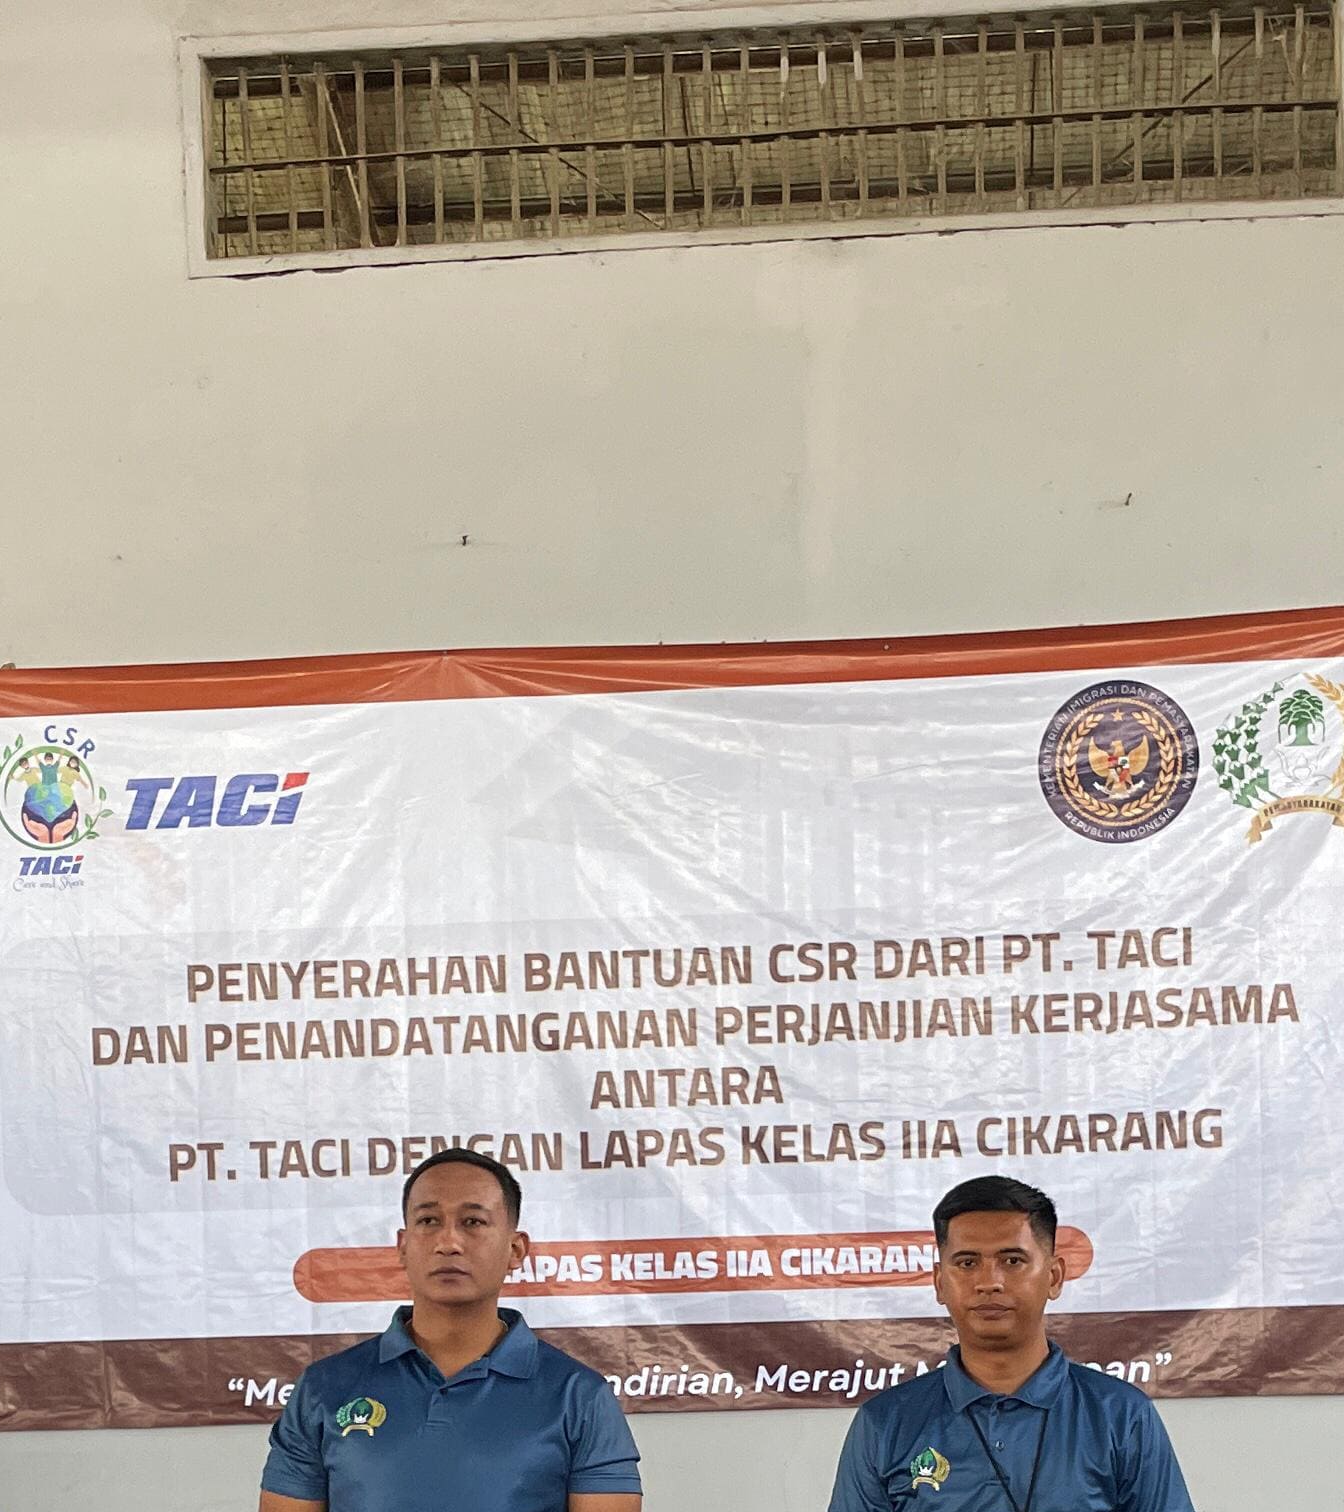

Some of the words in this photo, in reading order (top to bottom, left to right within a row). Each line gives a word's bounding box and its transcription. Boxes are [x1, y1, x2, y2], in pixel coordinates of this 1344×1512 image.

[1068, 685, 1118, 715] IMIGRASI
[1120, 684, 1147, 698] DAN
[1064, 810, 1116, 840] REPUBLIK
[1117, 807, 1176, 840] INDONESIA
[187, 954, 507, 1002] PENYERAHAN
[523, 944, 752, 992] BANTUAN
[768, 942, 857, 983] CSR
[874, 936, 984, 979] DARI
[1002, 932, 1073, 973] PT.
[1087, 927, 1193, 970] TACI
[92, 1025, 188, 1066] DAN
[205, 1008, 697, 1062] PENANDATANGANAN
[715, 997, 993, 1045] PERJANJIAN
[1010, 983, 1300, 1035] KERJASAMA
[591, 1065, 783, 1110] ANTARA
[168, 1143, 236, 1182] PT.
[250, 1138, 350, 1179] TACI
[580, 1126, 725, 1169] LAPAS
[741, 1121, 885, 1165] KELAS
[902, 1119, 962, 1160] IIA
[976, 1109, 1223, 1156] CIKARANG
[611, 1250, 718, 1281] KELAS
[726, 1249, 773, 1277] IIA
[781, 1244, 940, 1277] CIKARAN
[604, 1364, 743, 1399] ndirian,
[754, 1360, 905, 1398] Merajut
